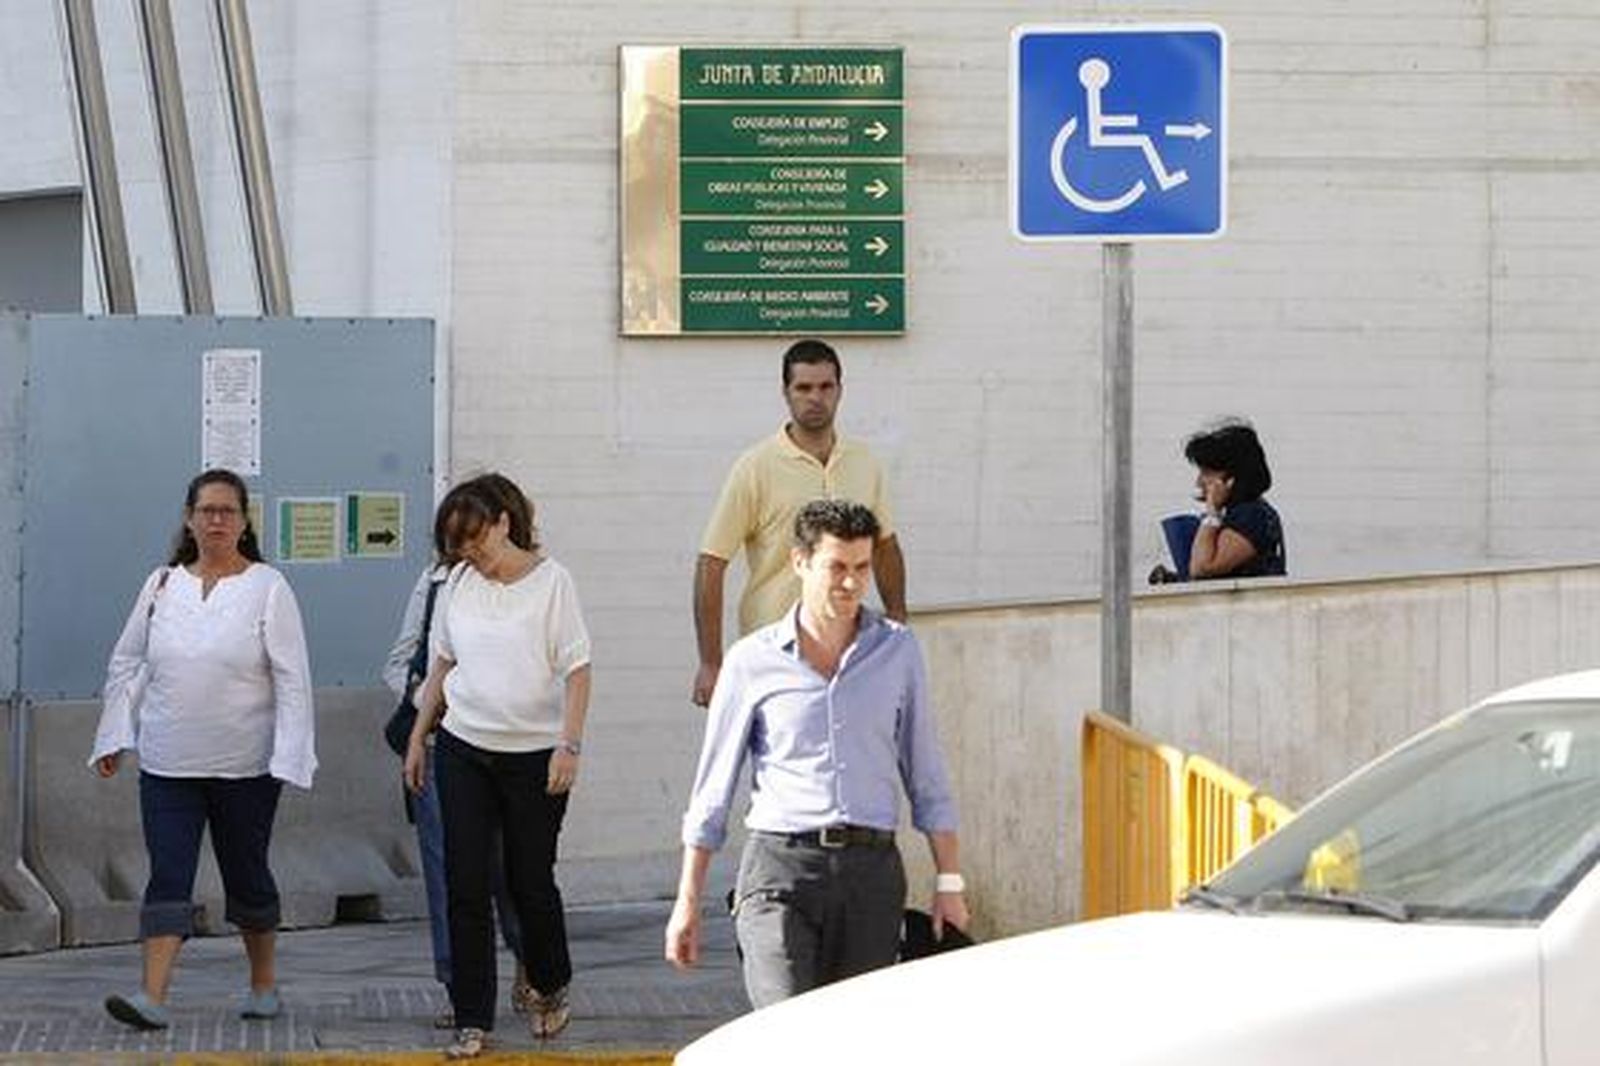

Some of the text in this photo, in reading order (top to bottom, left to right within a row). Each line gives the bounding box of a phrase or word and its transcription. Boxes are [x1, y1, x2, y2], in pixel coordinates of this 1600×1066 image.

[699, 65, 754, 84] JUNTA
[762, 65, 783, 84] DE
[793, 116, 806, 129] DE
[808, 116, 848, 129] EMPLEO
[834, 168, 846, 180] DE
[708, 181, 741, 193] OBRAS
[809, 225, 834, 236] PARA
[836, 225, 848, 236] LA
[704, 240, 754, 252] IGUALDAD
[763, 240, 812, 252] BIENESTAR
[814, 240, 848, 252] SOCIAL
[749, 290, 762, 302] DE
[765, 290, 798, 302] MEDIO
[800, 290, 849, 302] AMBIENTE
